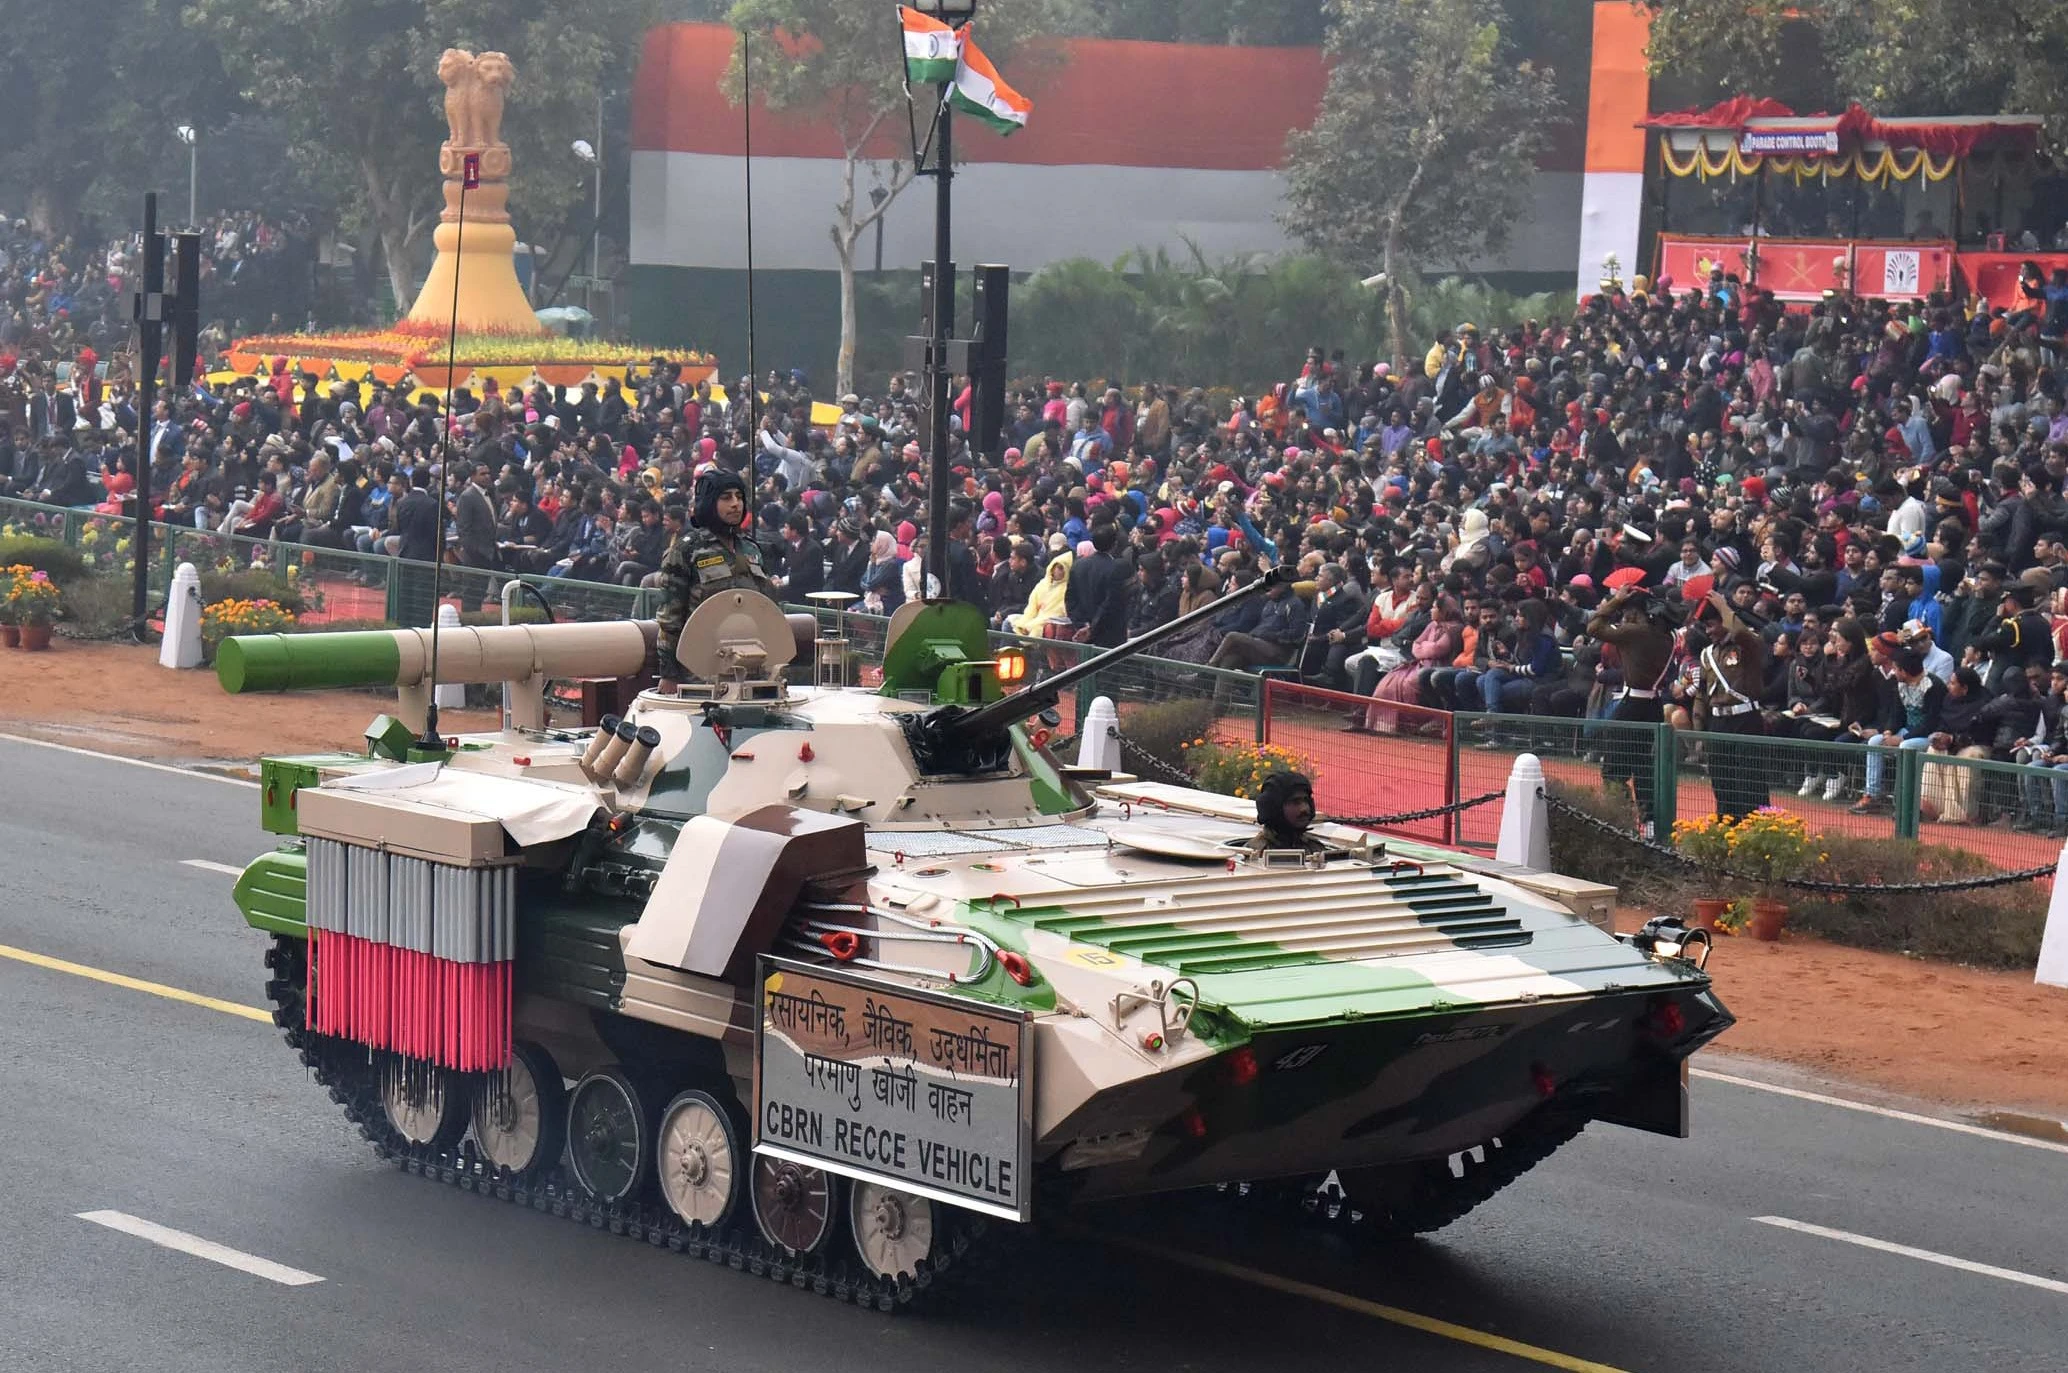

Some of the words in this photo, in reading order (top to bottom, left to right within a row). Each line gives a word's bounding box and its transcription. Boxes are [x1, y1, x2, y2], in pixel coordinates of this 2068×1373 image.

[1776, 136, 1804, 149] CONTROL
[766, 989, 850, 1049] रसायनिक,
[862, 997, 918, 1064] जैविक,
[804, 1051, 862, 1112] परमाणु
[871, 1058, 918, 1113] खोजी
[928, 1082, 974, 1126] वाहन
[766, 1100, 823, 1147] CBRN
[834, 1117, 906, 1169] RECCE
[918, 1138, 1011, 1197] VEHICLE
